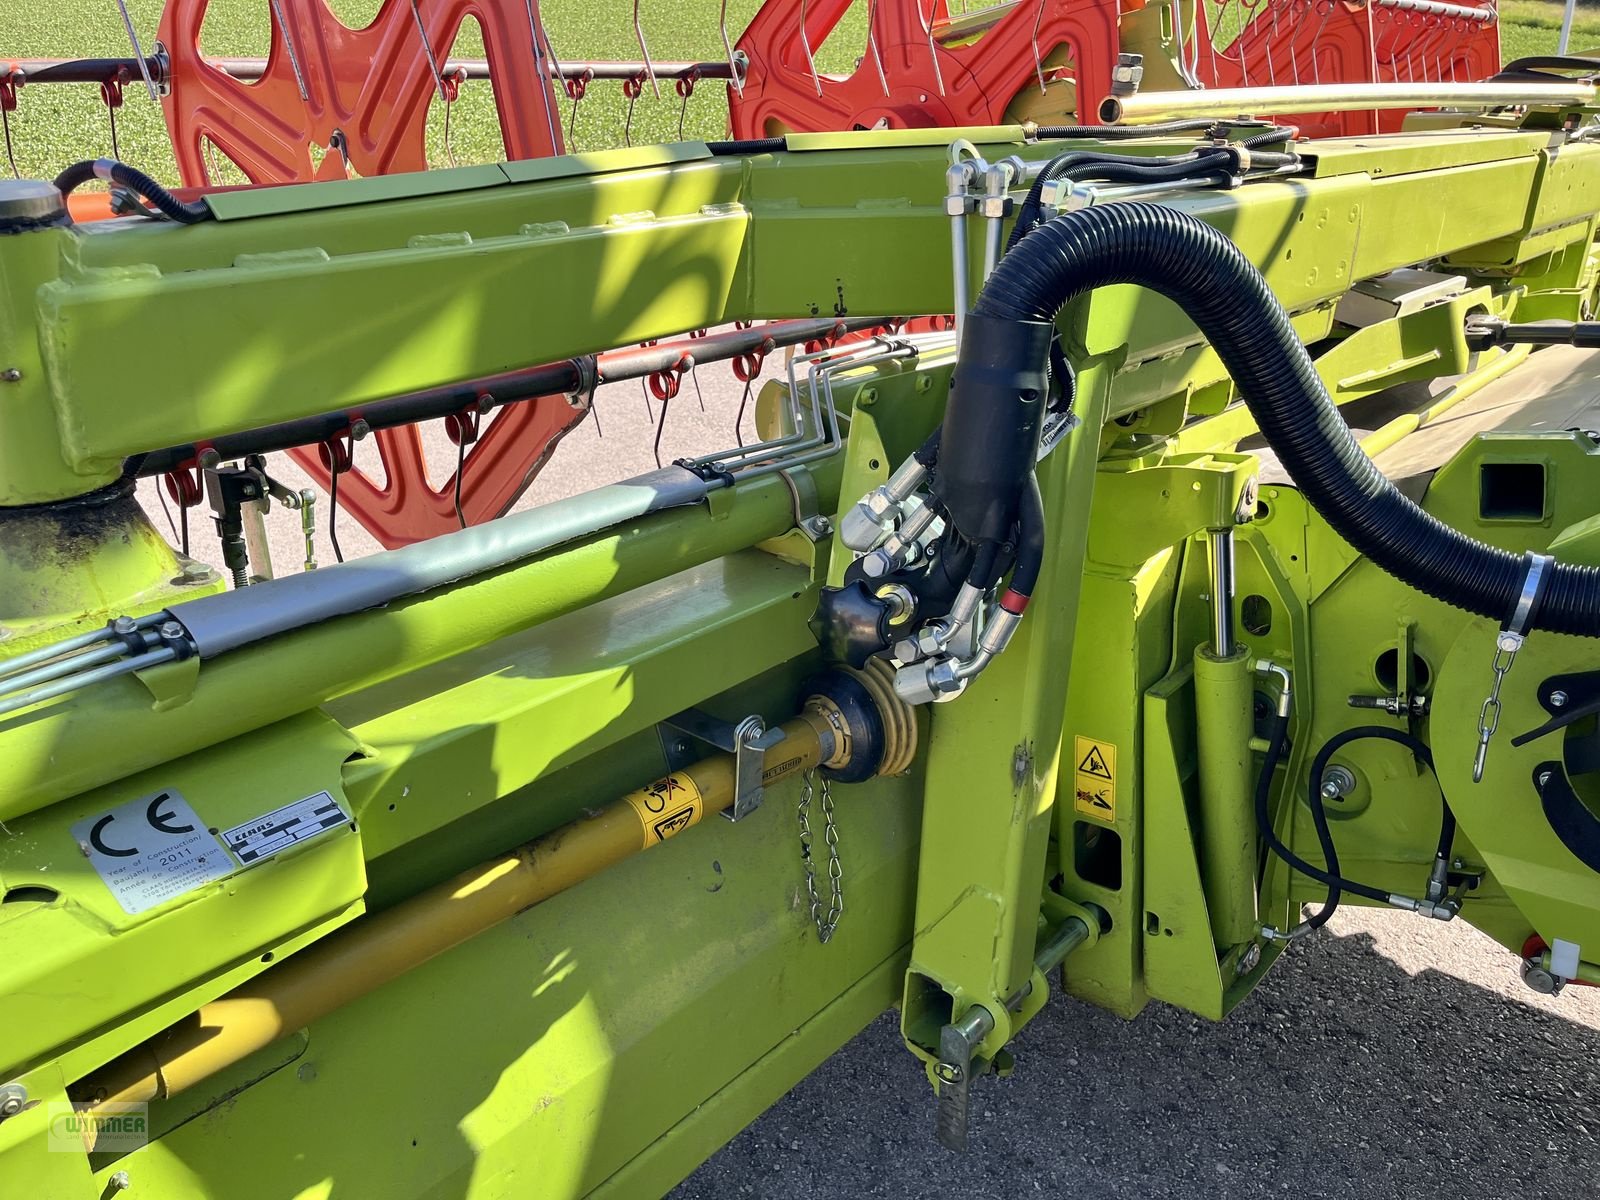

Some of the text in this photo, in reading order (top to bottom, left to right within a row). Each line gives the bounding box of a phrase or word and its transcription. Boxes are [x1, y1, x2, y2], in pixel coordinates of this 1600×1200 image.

[90, 793, 195, 857] CE
[235, 822, 274, 841] CLAAS
[108, 835, 201, 877] Year of Construction/
[120, 879, 145, 894] Année
[152, 871, 162, 879] de
[168, 848, 219, 872] Construction
[160, 848, 192, 866] 2011
[113, 866, 150, 886] Baujahr/
